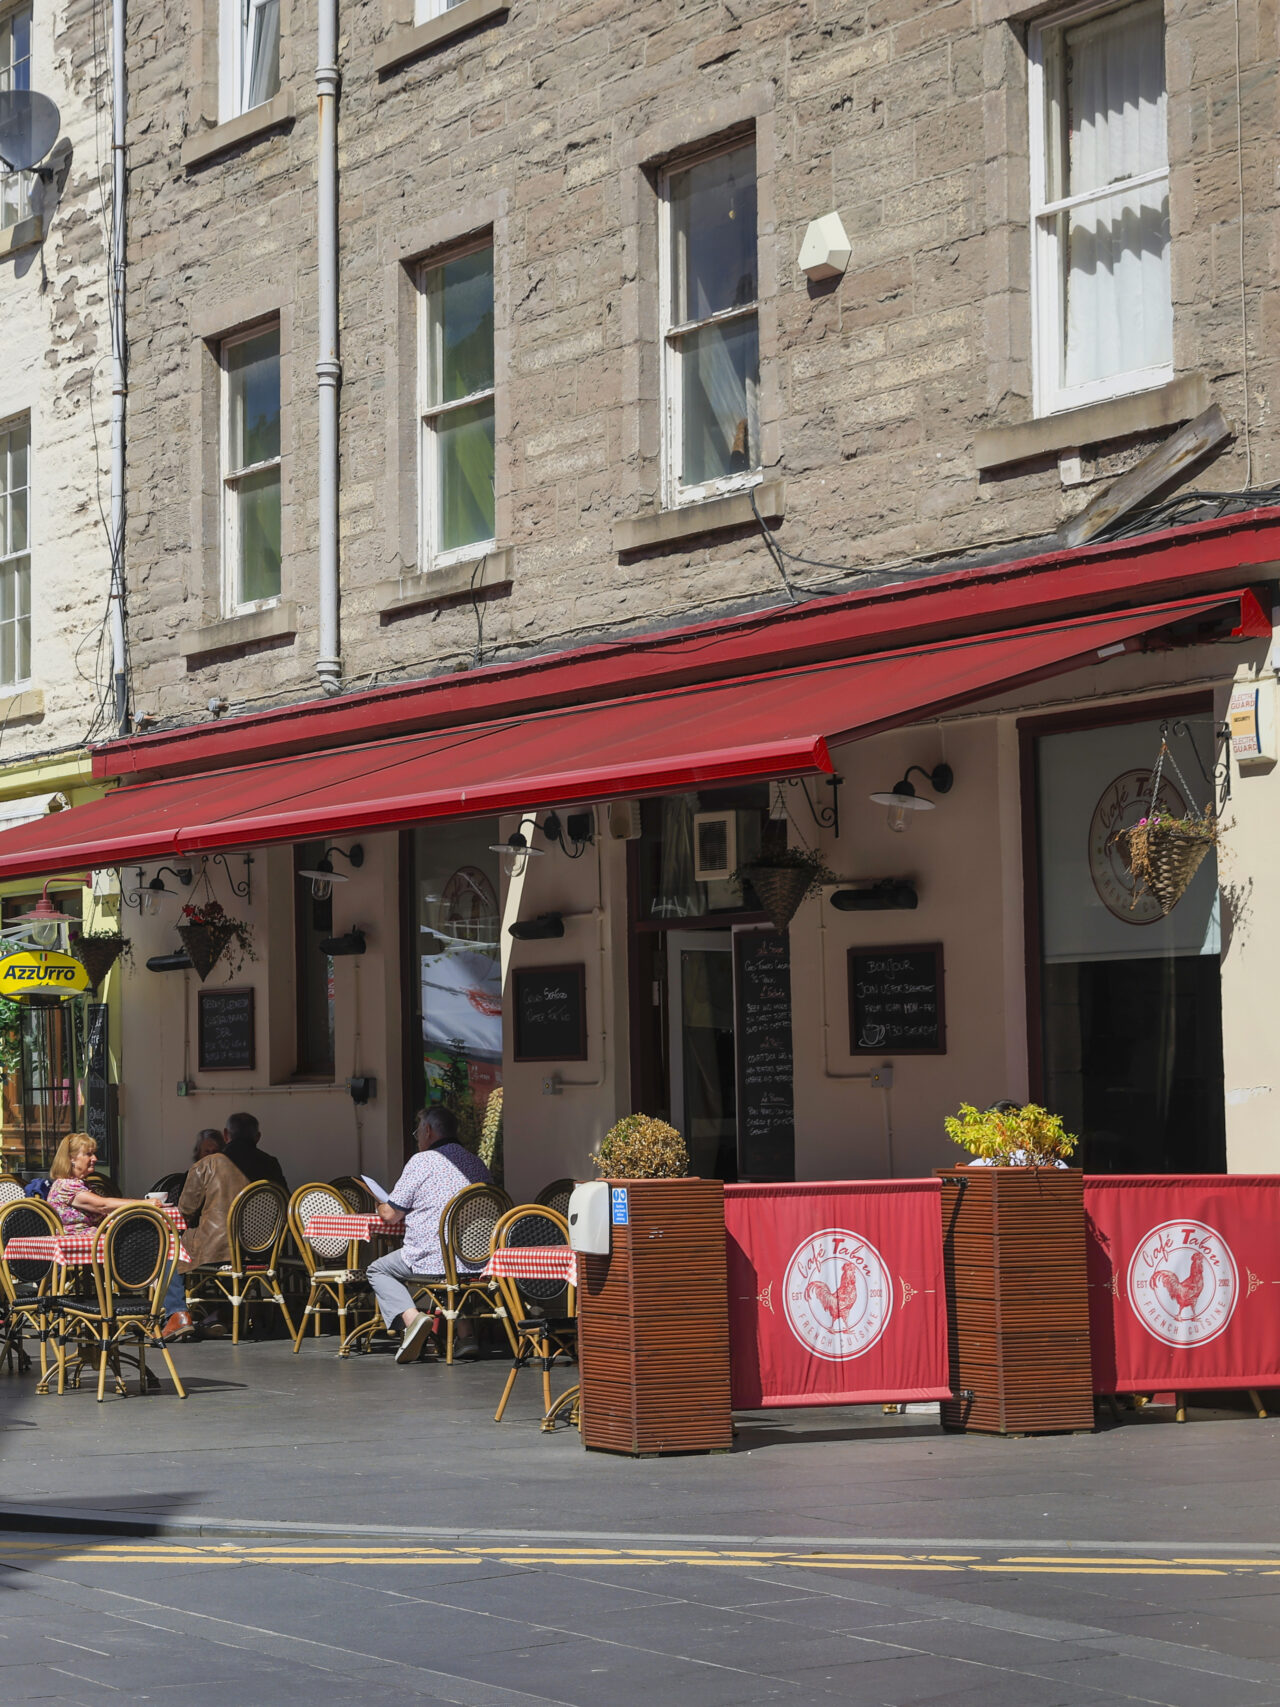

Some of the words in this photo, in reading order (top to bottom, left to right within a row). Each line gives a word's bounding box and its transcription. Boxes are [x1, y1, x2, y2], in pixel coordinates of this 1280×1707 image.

[1231, 701, 1255, 710] GUARD
[1233, 744, 1257, 753] GUARD
[797, 1243, 827, 1279] Café
[1142, 1233, 1174, 1268] Café
[1136, 1280, 1148, 1289] EST
[792, 1291, 803, 1301] EST
[1143, 1300, 1179, 1335] FRENCH
[1187, 1301, 1226, 1336] CUISINE
[798, 1312, 833, 1348] FRENCH
[839, 1311, 879, 1348] CUISINE
